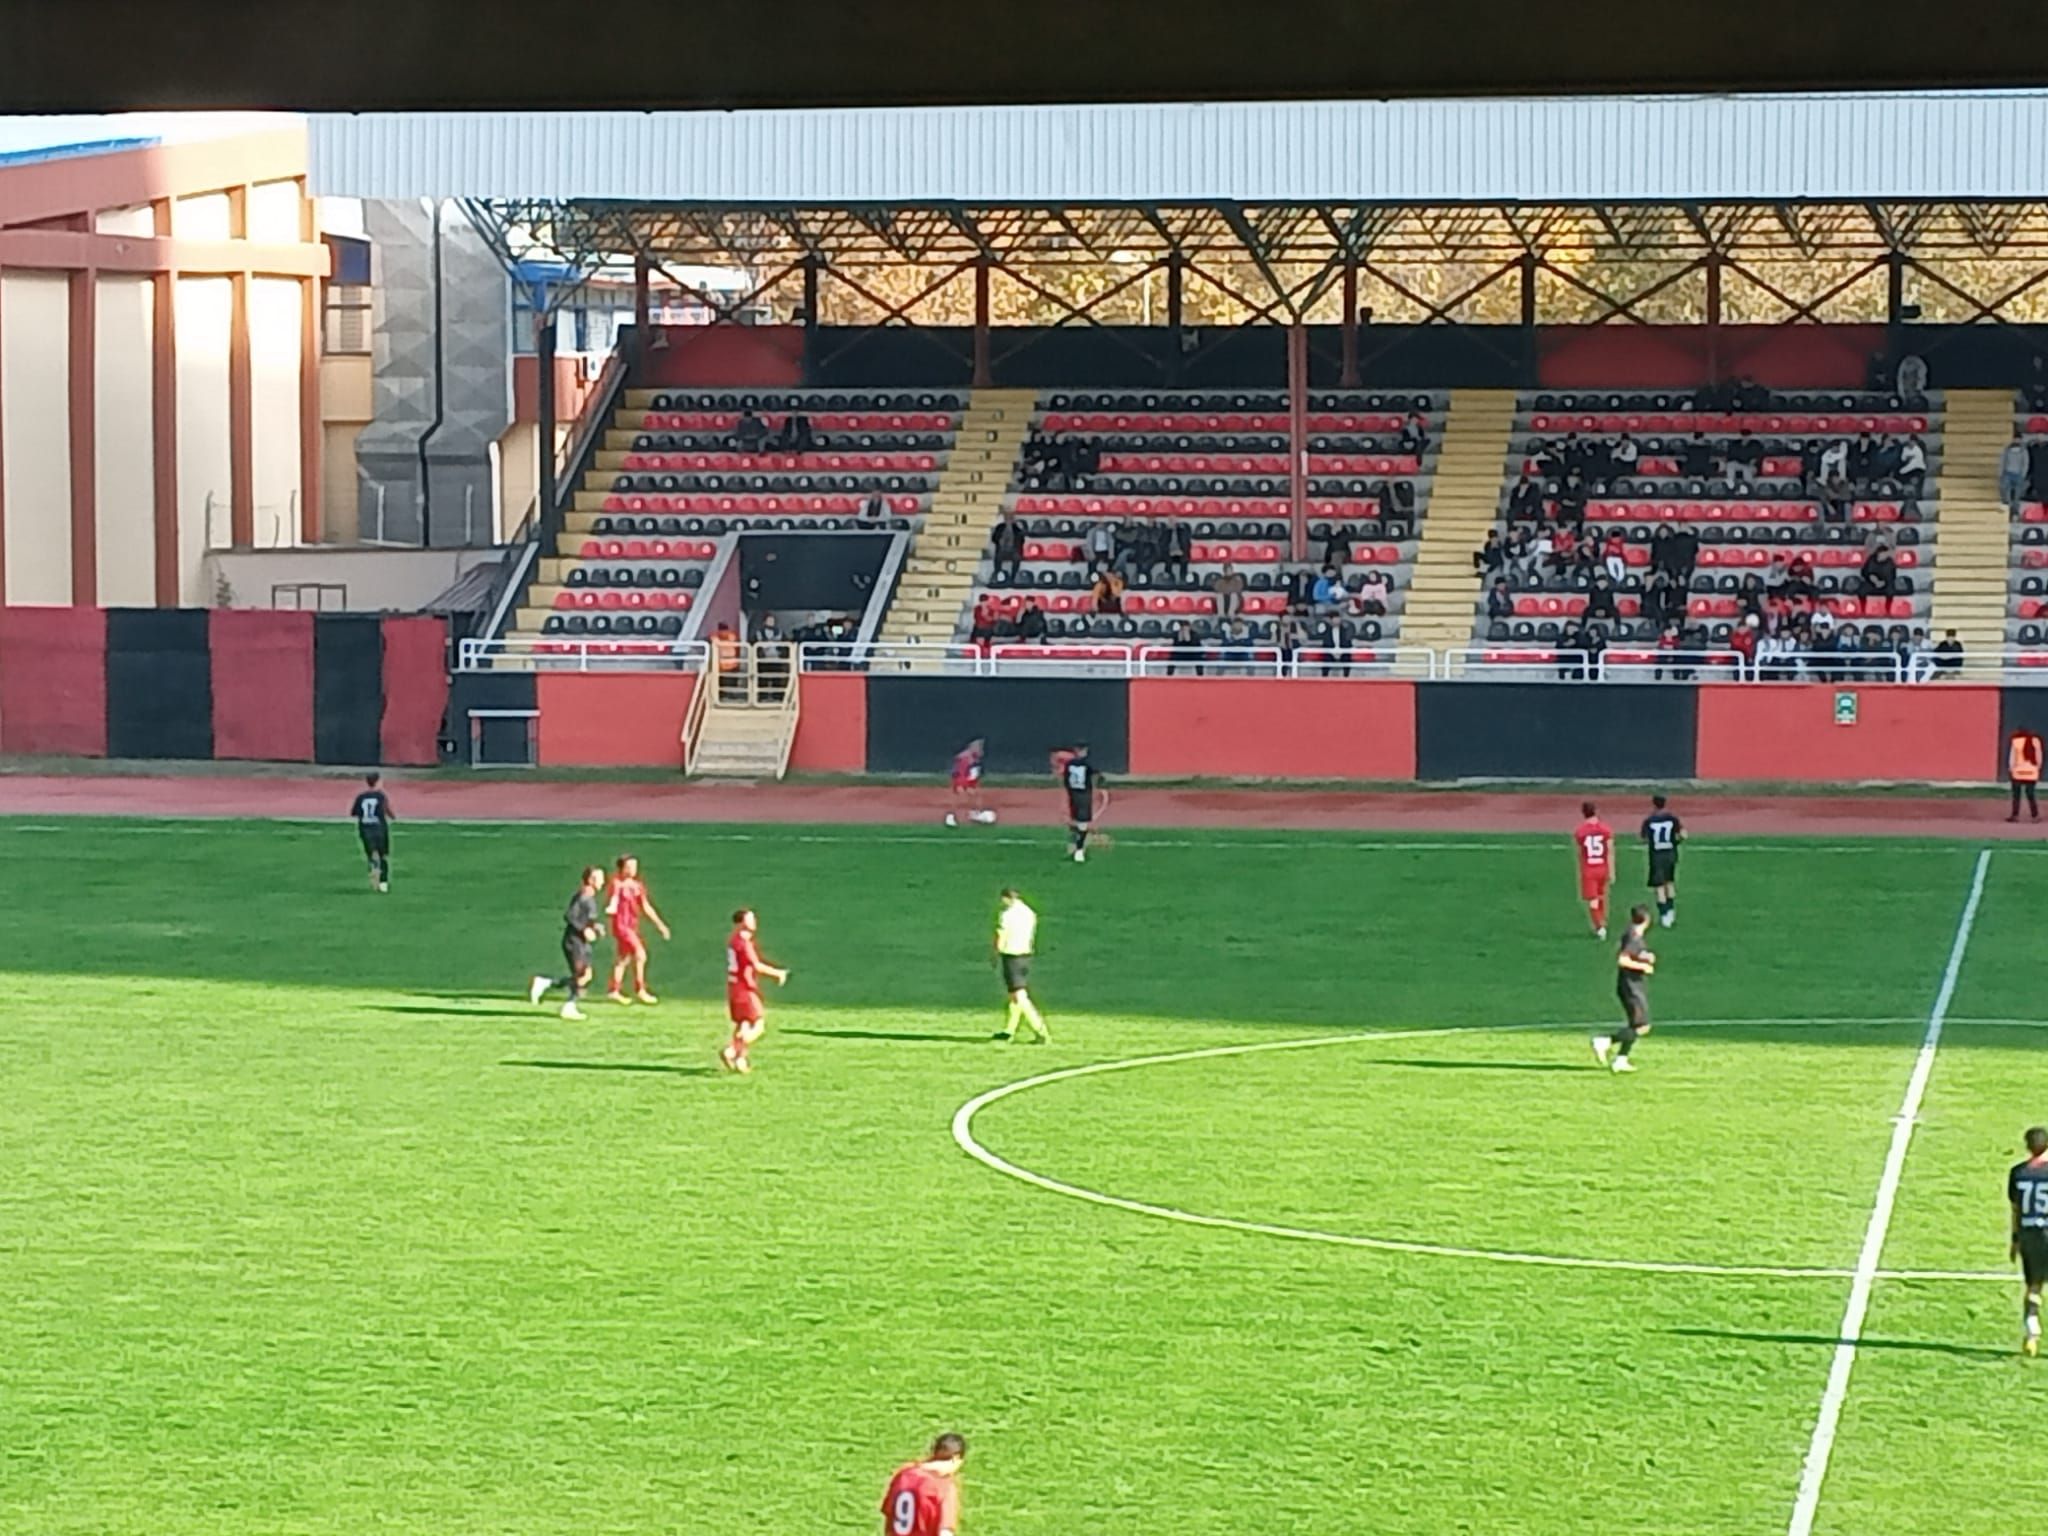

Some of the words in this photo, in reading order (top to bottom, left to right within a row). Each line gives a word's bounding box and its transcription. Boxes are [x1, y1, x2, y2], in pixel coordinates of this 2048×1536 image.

[1649, 821, 1673, 843] 77
[1584, 835, 1604, 857] 15
[2016, 1181, 2048, 1213] 75
[893, 1490, 915, 1535] 9
